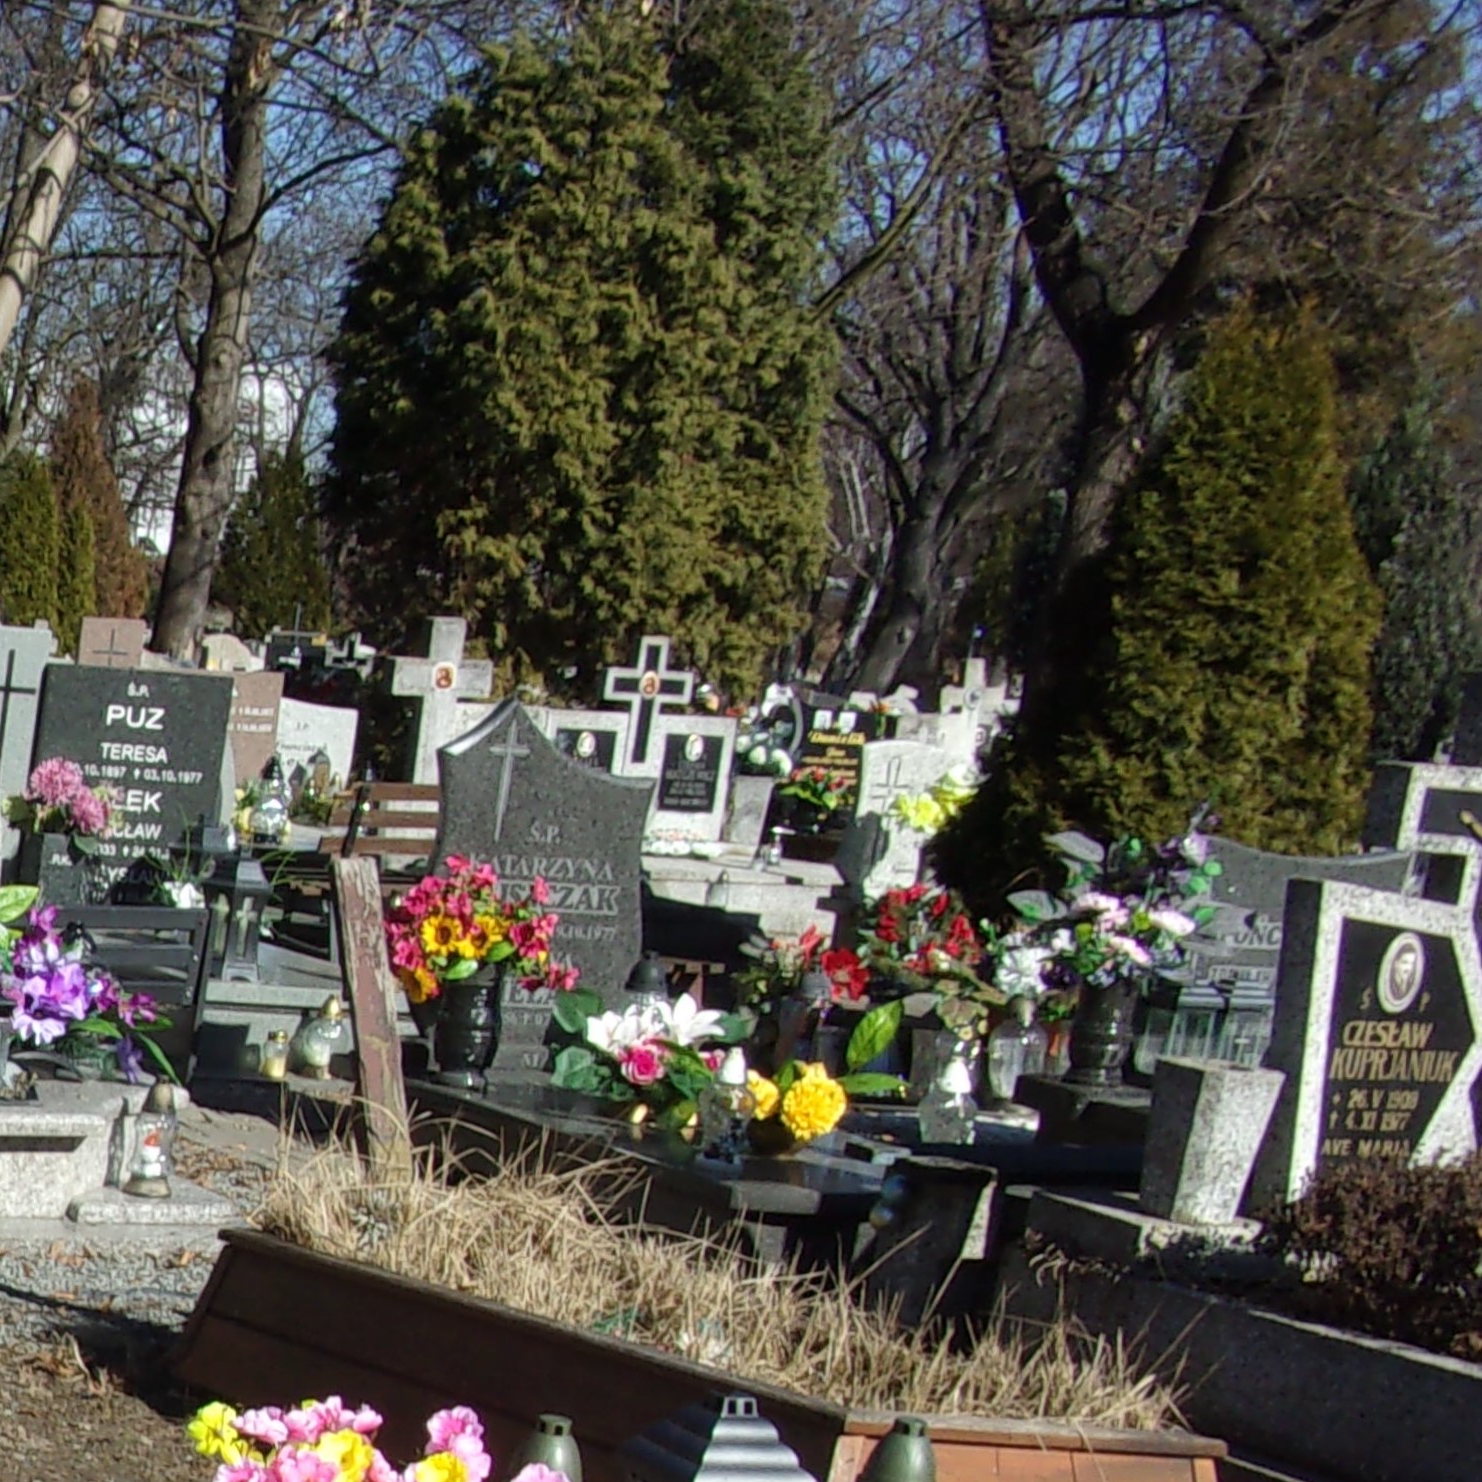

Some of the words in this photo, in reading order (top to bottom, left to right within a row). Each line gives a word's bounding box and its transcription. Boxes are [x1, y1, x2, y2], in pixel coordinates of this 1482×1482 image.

[105, 703, 166, 730] PUZ
[100, 742, 168, 764] TERESA
[1342, 1019, 1435, 1049] CZESŁAW
[1328, 1047, 1460, 1082] KUPRJANIUK
